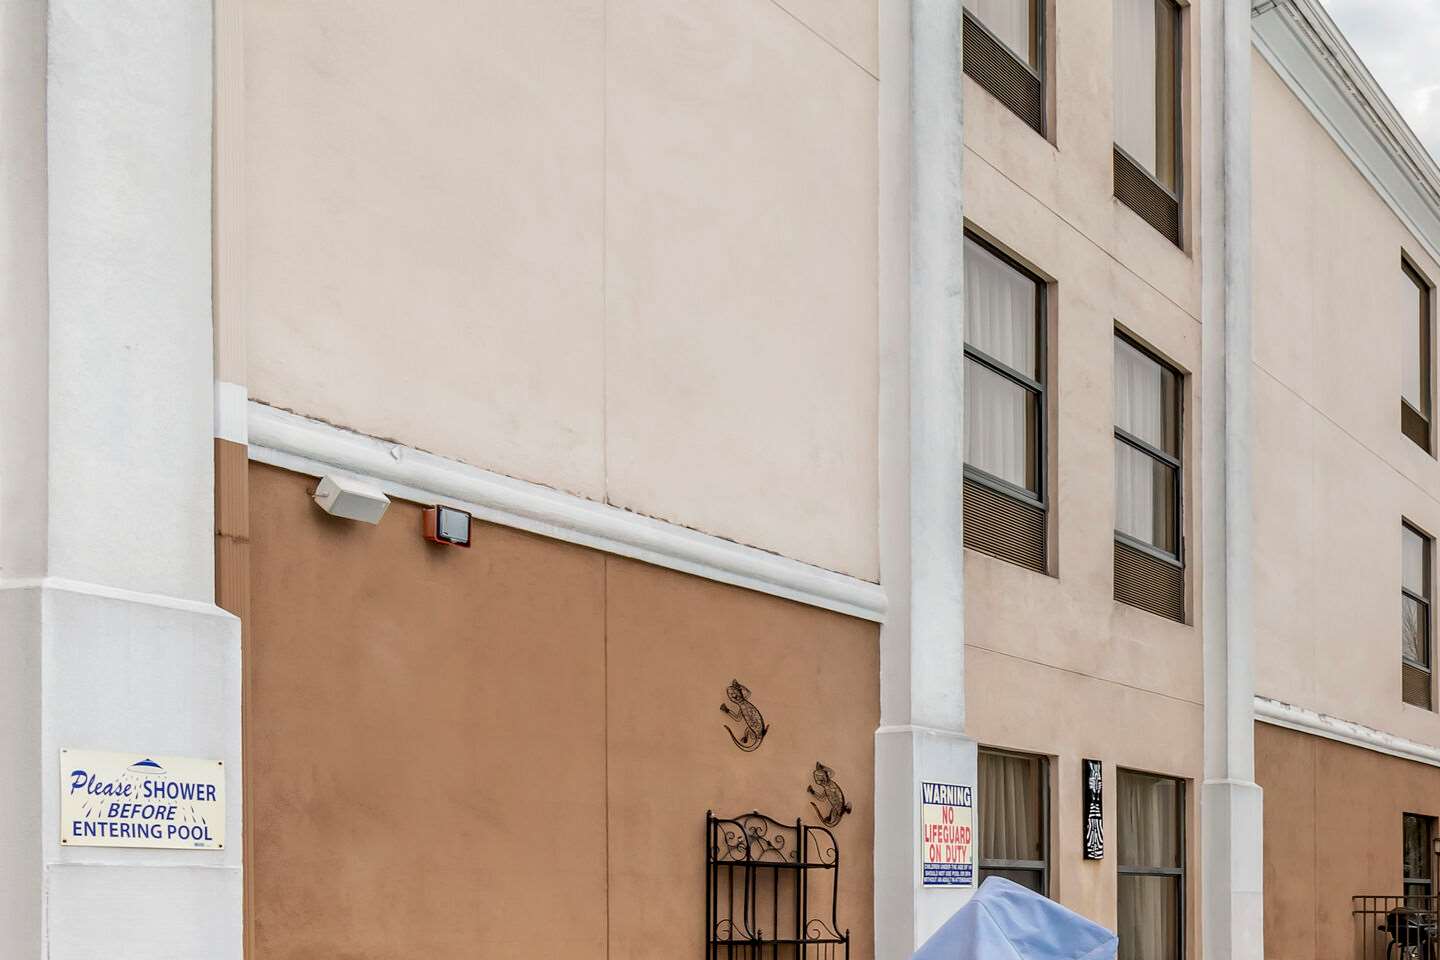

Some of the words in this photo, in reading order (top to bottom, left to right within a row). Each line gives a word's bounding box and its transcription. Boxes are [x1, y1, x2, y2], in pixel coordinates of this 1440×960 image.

[70, 770, 132, 797] Please
[143, 780, 217, 801] SHOWER
[924, 784, 971, 806] WARNING
[107, 803, 178, 821] BEFORE
[942, 807, 955, 824] NO
[73, 821, 162, 839] ENTERING
[167, 824, 213, 841] POOL
[924, 824, 971, 845] LIFEGUARD
[930, 845, 942, 863] ON
[946, 845, 967, 863] DUTY
